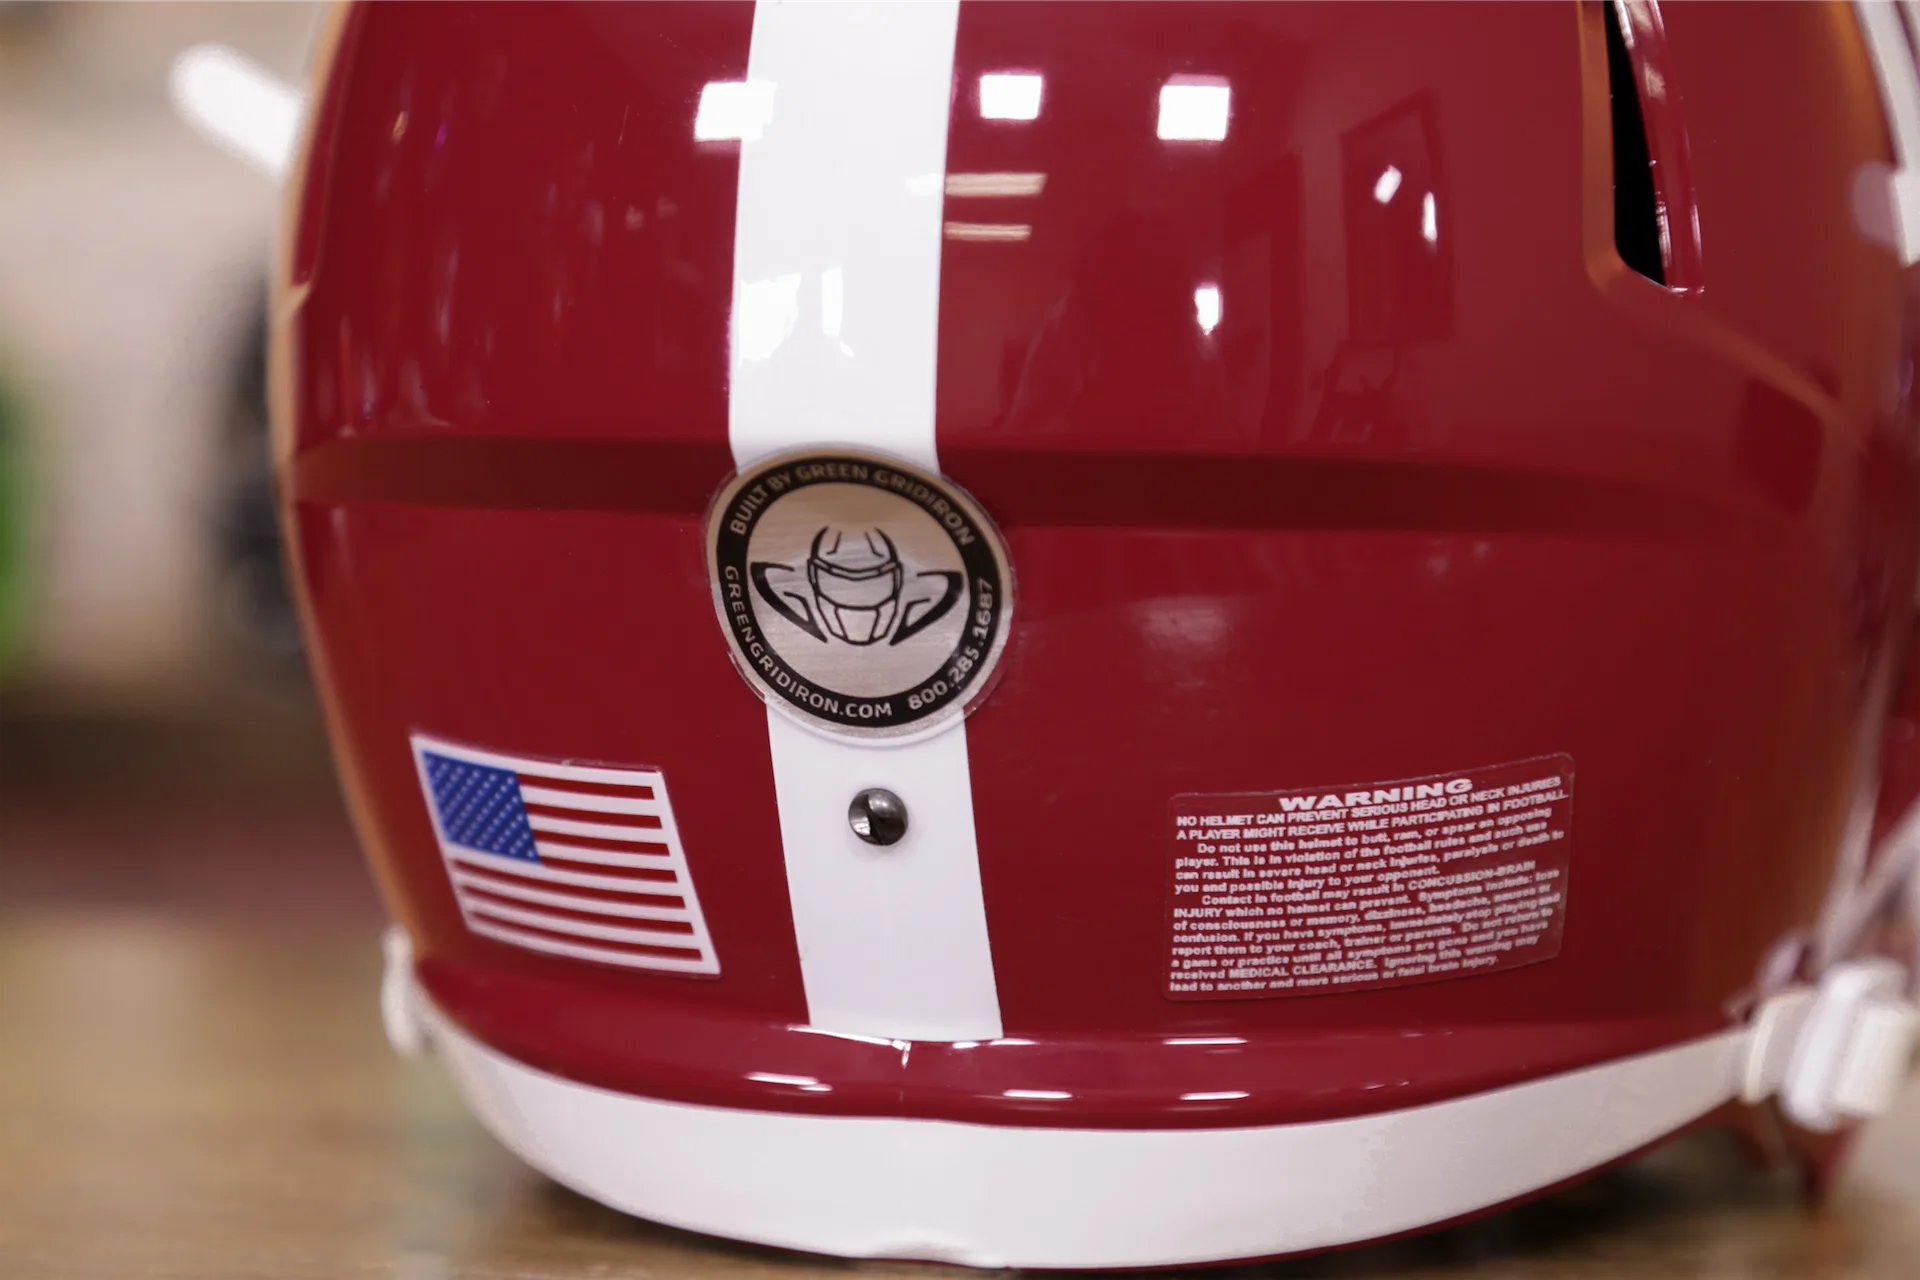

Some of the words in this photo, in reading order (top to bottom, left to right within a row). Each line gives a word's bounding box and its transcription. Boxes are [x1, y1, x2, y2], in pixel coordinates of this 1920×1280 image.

[730, 487, 770, 536] BUILT
[770, 471, 793, 491] BY
[796, 461, 868, 481] GREEN
[874, 470, 976, 546] GRIDIRON
[725, 566, 892, 718] GREENGRIDIRON.COM
[907, 578, 993, 710] 800.285.1687
[1177, 816, 1197, 826] NO
[1200, 815, 1254, 826] HELMET
[1256, 813, 1285, 824] CAN
[1288, 809, 1349, 822] PREVENT
[1351, 804, 1408, 817] SERIOUS
[1410, 798, 1447, 812] HEAD
[1449, 795, 1469, 806] OR
[1470, 789, 1505, 803] NECK
[1507, 776, 1561, 795] INJURIES
[1279, 778, 1472, 811] WARNING
[1175, 857, 1219, 869] player.
[1223, 856, 1250, 866] This
[1254, 855, 1265, 865] is
[1269, 854, 1282, 864] in
[1285, 850, 1340, 863] violation
[1344, 848, 1358, 859] of
[1360, 845, 1380, 856] the
[1383, 840, 1432, 855] football
[1434, 836, 1465, 849] rules
[1469, 831, 1492, 843] and
[1494, 825, 1524, 838] such
[1526, 821, 1548, 832] use
[1176, 830, 1187, 840] A
[1189, 829, 1240, 840] PLAYER
[1243, 827, 1286, 838] MIGHT
[1288, 823, 1346, 836] RECEIVE
[1347, 818, 1389, 831] WHILE
[1392, 805, 1484, 827] PARTICIPATING
[1487, 803, 1500, 813] IN
[1197, 843, 1216, 853] Do
[1219, 843, 1241, 852] not
[1244, 842, 1267, 852] use
[1270, 840, 1295, 851] this
[1298, 837, 1343, 850] helmet
[1345, 836, 1358, 846] to
[1424, 827, 1439, 836] or
[1442, 821, 1475, 836] spear
[1478, 819, 1494, 829] an
[1498, 806, 1552, 826] opposing
[1176, 870, 1199, 880] can
[1202, 868, 1240, 879] result
[1243, 868, 1256, 878] in
[1259, 866, 1301, 878] severe
[1305, 863, 1336, 875] head
[1340, 863, 1353, 873] or
[1356, 859, 1387, 872] neck
[1444, 842, 1499, 862] paralysis
[1502, 840, 1515, 850] or
[1517, 834, 1550, 848] death
[1552, 829, 1564, 840] to
[1174, 883, 1199, 895] you
[1202, 882, 1227, 893] and
[1229, 881, 1284, 893] possible
[1287, 877, 1325, 890] injury
[1328, 875, 1341, 886] to
[1344, 874, 1374, 887] your
[1377, 865, 1440, 885] opponent.
[1174, 907, 1223, 918] INJURY
[1225, 905, 1264, 917] which
[1267, 906, 1284, 916] no
[1287, 902, 1330, 915] helmet
[1334, 900, 1357, 911] can
[1359, 893, 1411, 911] prevent.
[1418, 884, 1483, 903] Symptoms
[1485, 875, 1533, 891] include:
[1535, 869, 1560, 882] loss
[1201, 893, 1252, 905] Contact
[1255, 892, 1268, 903] in
[1270, 889, 1320, 903] football
[1323, 887, 1350, 900] may
[1353, 881, 1389, 897] result
[1392, 880, 1405, 891] in
[1172, 945, 1212, 956] report
[1214, 943, 1247, 955] them
[1250, 943, 1263, 954] to
[1266, 943, 1296, 955] your
[1299, 939, 1342, 951] coach,
[1344, 934, 1387, 947] trainer
[1389, 932, 1403, 943] or
[1405, 926, 1455, 942] parents.
[1461, 921, 1479, 932] Do
[1482, 917, 1503, 929] not
[1504, 911, 1539, 925] return
[1541, 907, 1553, 917] to
[1173, 921, 1188, 931] of
[1190, 919, 1286, 931] consciousness
[1289, 918, 1303, 927] or
[1494, 887, 1536, 902] nausea
[1539, 884, 1551, 893] or
[1173, 932, 1240, 943] confusion.
[1244, 932, 1255, 942] If
[1256, 932, 1280, 943] you
[1284, 928, 1314, 939] have
[1464, 907, 1492, 920] stop
[1494, 897, 1538, 916] playing
[1538, 893, 1561, 906] and
[1170, 969, 1225, 980] received
[1229, 966, 1289, 979] MEDICAL
[1292, 958, 1378, 975] CLEARANCE.
[1384, 951, 1436, 968] Ignoring
[1439, 947, 1462, 960] this
[1466, 939, 1512, 956] warning
[1515, 935, 1540, 948] may
[1183, 958, 1218, 969] game
[1221, 958, 1234, 967] or
[1237, 955, 1290, 968] practice
[1293, 952, 1321, 964] until
[1326, 950, 1342, 961] all
[1347, 943, 1412, 960] symptoms
[1415, 941, 1435, 951] are
[1438, 936, 1468, 950] gone
[1471, 931, 1494, 943] and
[1496, 927, 1518, 940] you
[1520, 920, 1549, 933] have
[1169, 981, 1197, 992] lead
[1200, 981, 1214, 991] to
[1217, 978, 1266, 991] another
[1269, 977, 1294, 988] and
[1297, 975, 1329, 987] more
[1332, 971, 1379, 985] serious
[1382, 969, 1396, 979] or
[1398, 964, 1425, 976] fatal
[1428, 961, 1460, 973] brain
